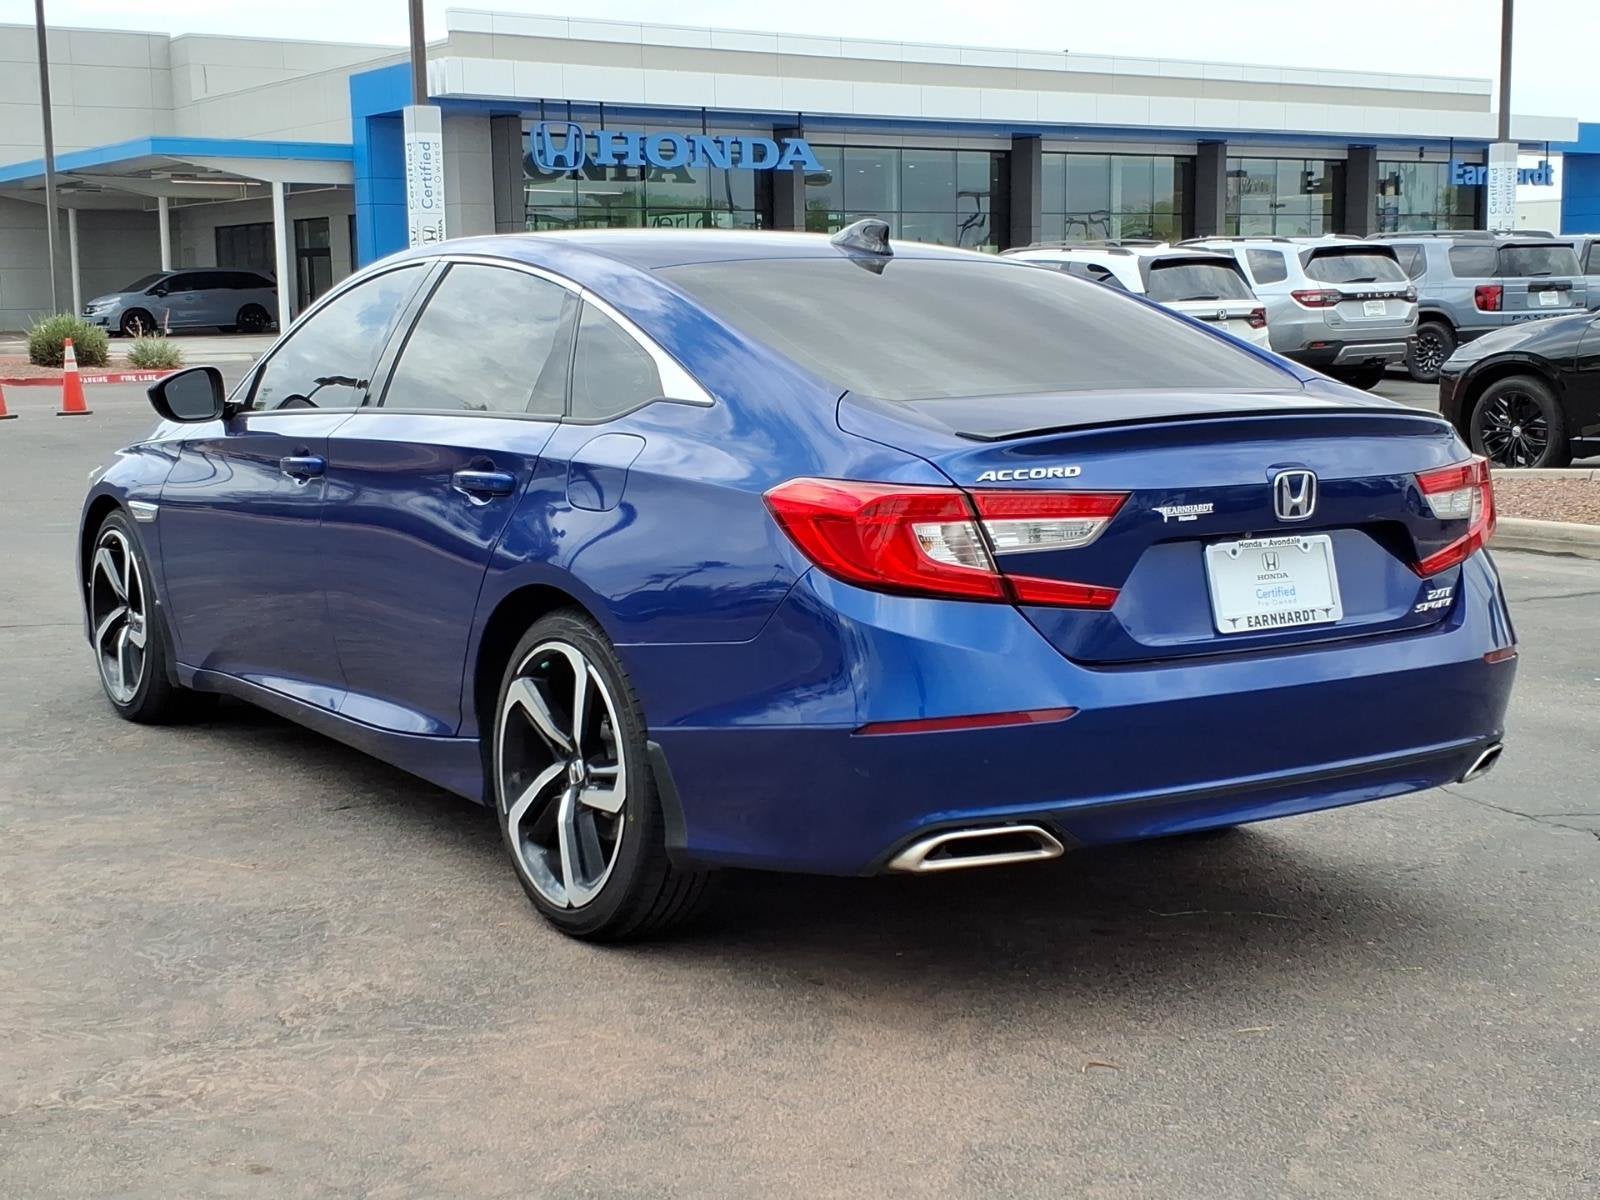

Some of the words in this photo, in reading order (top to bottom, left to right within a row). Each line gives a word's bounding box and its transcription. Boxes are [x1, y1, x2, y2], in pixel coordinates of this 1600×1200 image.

[594, 129, 824, 171] HONDA
[419, 141, 433, 210] Certified
[1356, 291, 1398, 299] PILOT
[975, 465, 1082, 483] ACCORD
[1166, 502, 1215, 515] EARNHARDT
[1238, 540, 1263, 549] Honda
[1268, 537, 1301, 547] Avondale
[1257, 572, 1289, 581] HONDA
[1255, 585, 1297, 599] Certified
[1246, 609, 1318, 628] EARNHARDT
